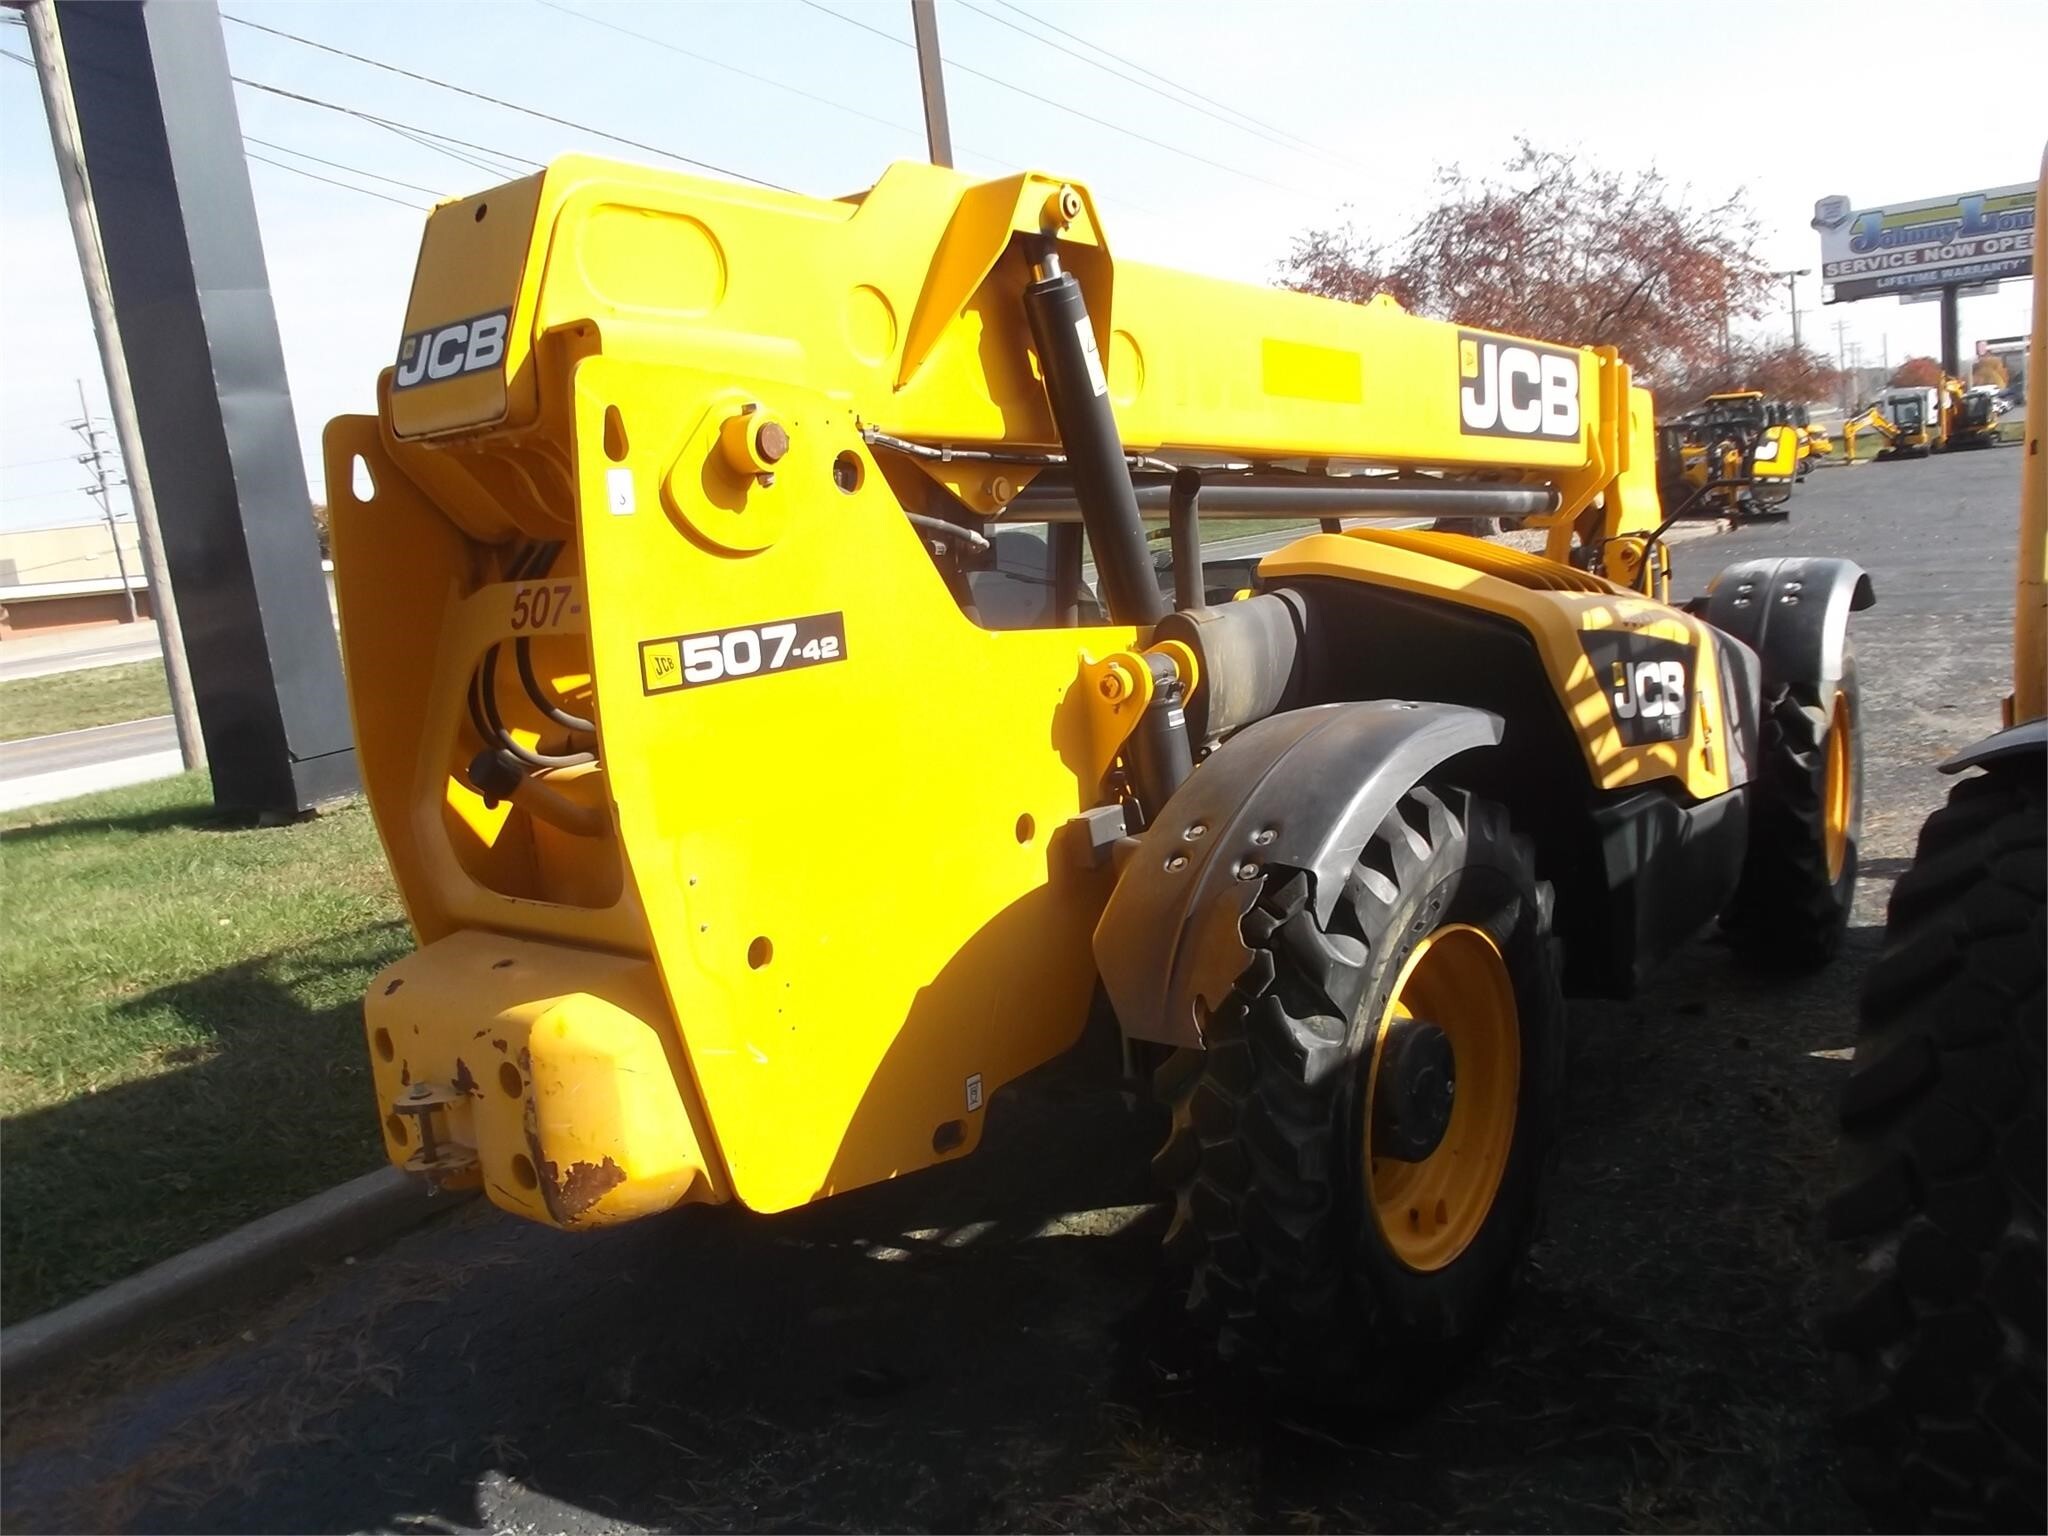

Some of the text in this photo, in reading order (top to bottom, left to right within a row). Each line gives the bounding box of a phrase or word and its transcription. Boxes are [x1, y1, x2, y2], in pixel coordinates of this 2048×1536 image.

[1850, 193, 2035, 253] Johnny Lon
[1825, 250, 1917, 277] SERVICE
[1924, 242, 1976, 265] NOW
[1876, 271, 1937, 288] LIFETIME
[397, 314, 508, 387] JCB
[1461, 343, 1580, 437] JCB
[654, 623, 840, 683] JCB 507-42
[1612, 661, 1686, 718] JCB
